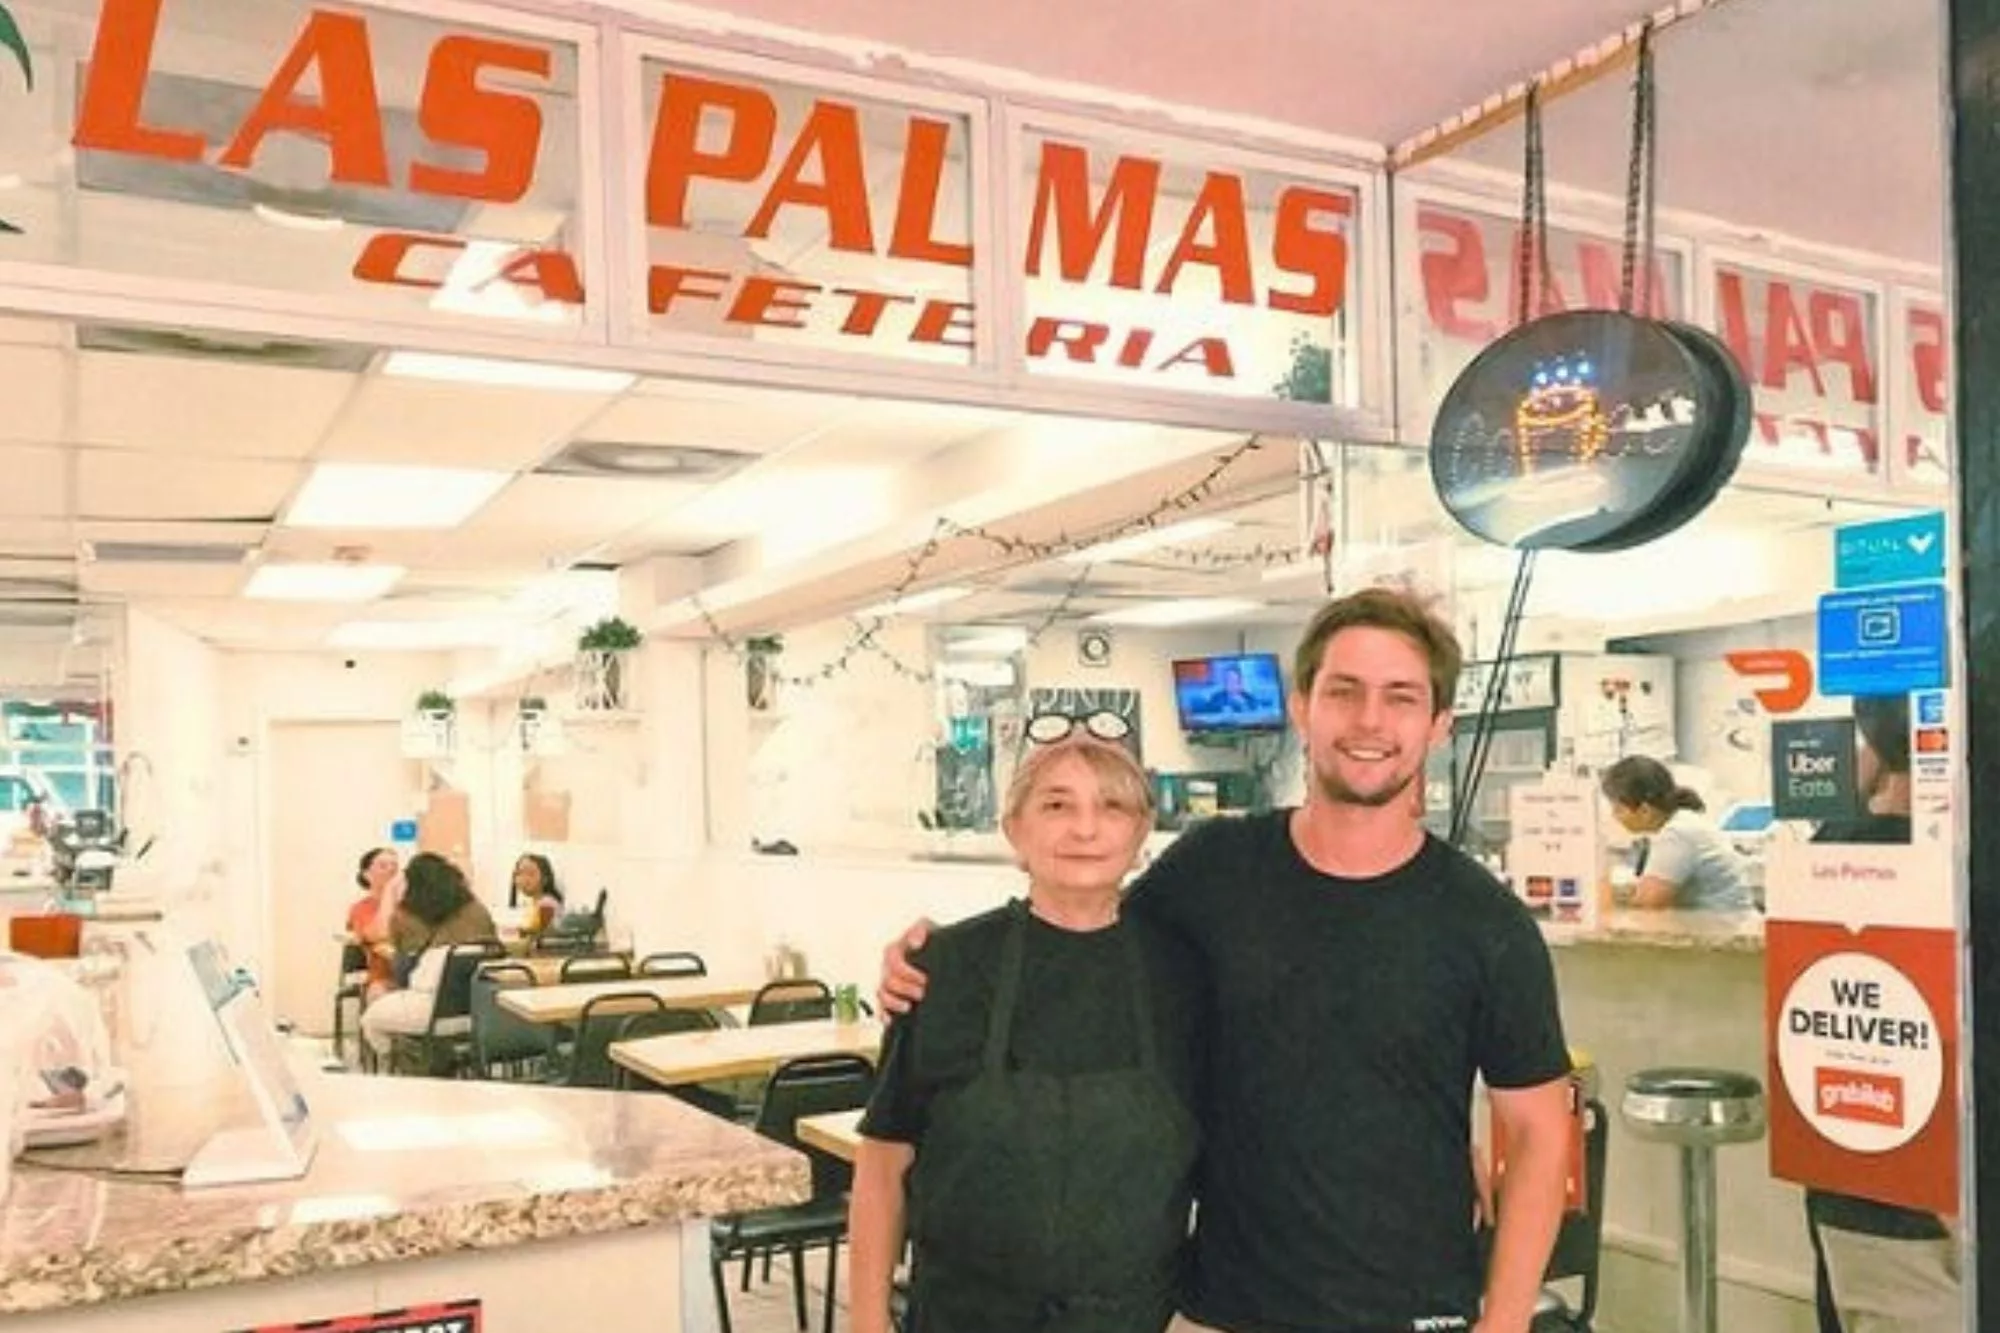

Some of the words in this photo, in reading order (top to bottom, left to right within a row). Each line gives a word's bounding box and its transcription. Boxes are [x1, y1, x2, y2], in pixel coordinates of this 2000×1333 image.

[71, 0, 551, 203] LAS
[646, 73, 1355, 317] PALMAS
[353, 232, 1235, 378] CAFETERIA
[1787, 751, 1836, 774] Uber
[1788, 777, 1836, 797] Eats
[1832, 979, 1881, 1009] WE
[1789, 1009, 1929, 1050] DELIVER!
